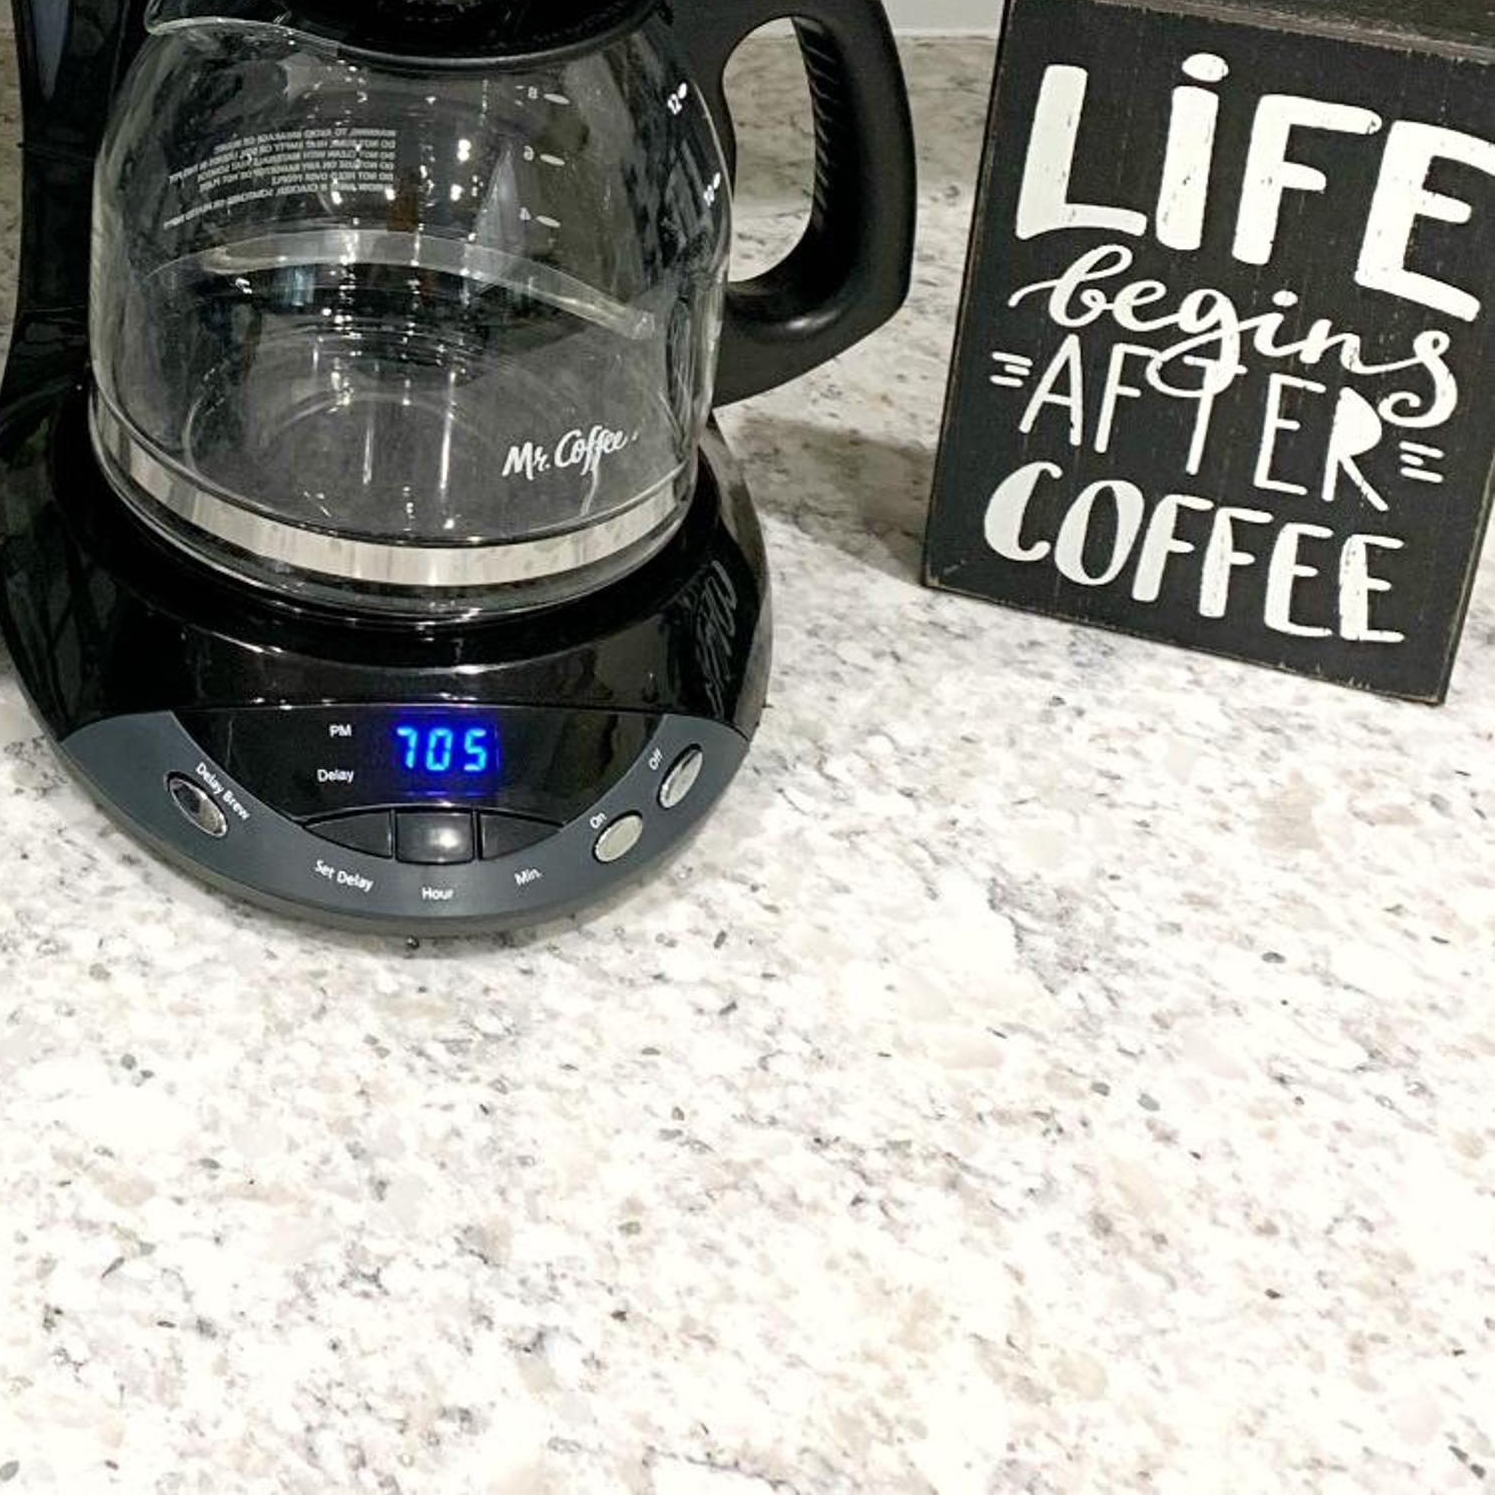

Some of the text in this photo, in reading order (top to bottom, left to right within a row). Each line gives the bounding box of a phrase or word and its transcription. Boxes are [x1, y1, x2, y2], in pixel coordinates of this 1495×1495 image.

[1008, 243, 1457, 428] begins
[1019, 335, 1389, 511] AFTER
[501, 424, 628, 481] Mr. Coffee
[983, 459, 1405, 643] COFFEE
[329, 723, 352, 738] PM
[647, 747, 664, 771] Off
[317, 768, 355, 784] Delay
[195, 761, 251, 821] Delay Brew
[589, 811, 607, 829] On
[314, 859, 374, 893] Set Delay
[514, 867, 543, 886] Min.
[421, 886, 455, 900] Hour
